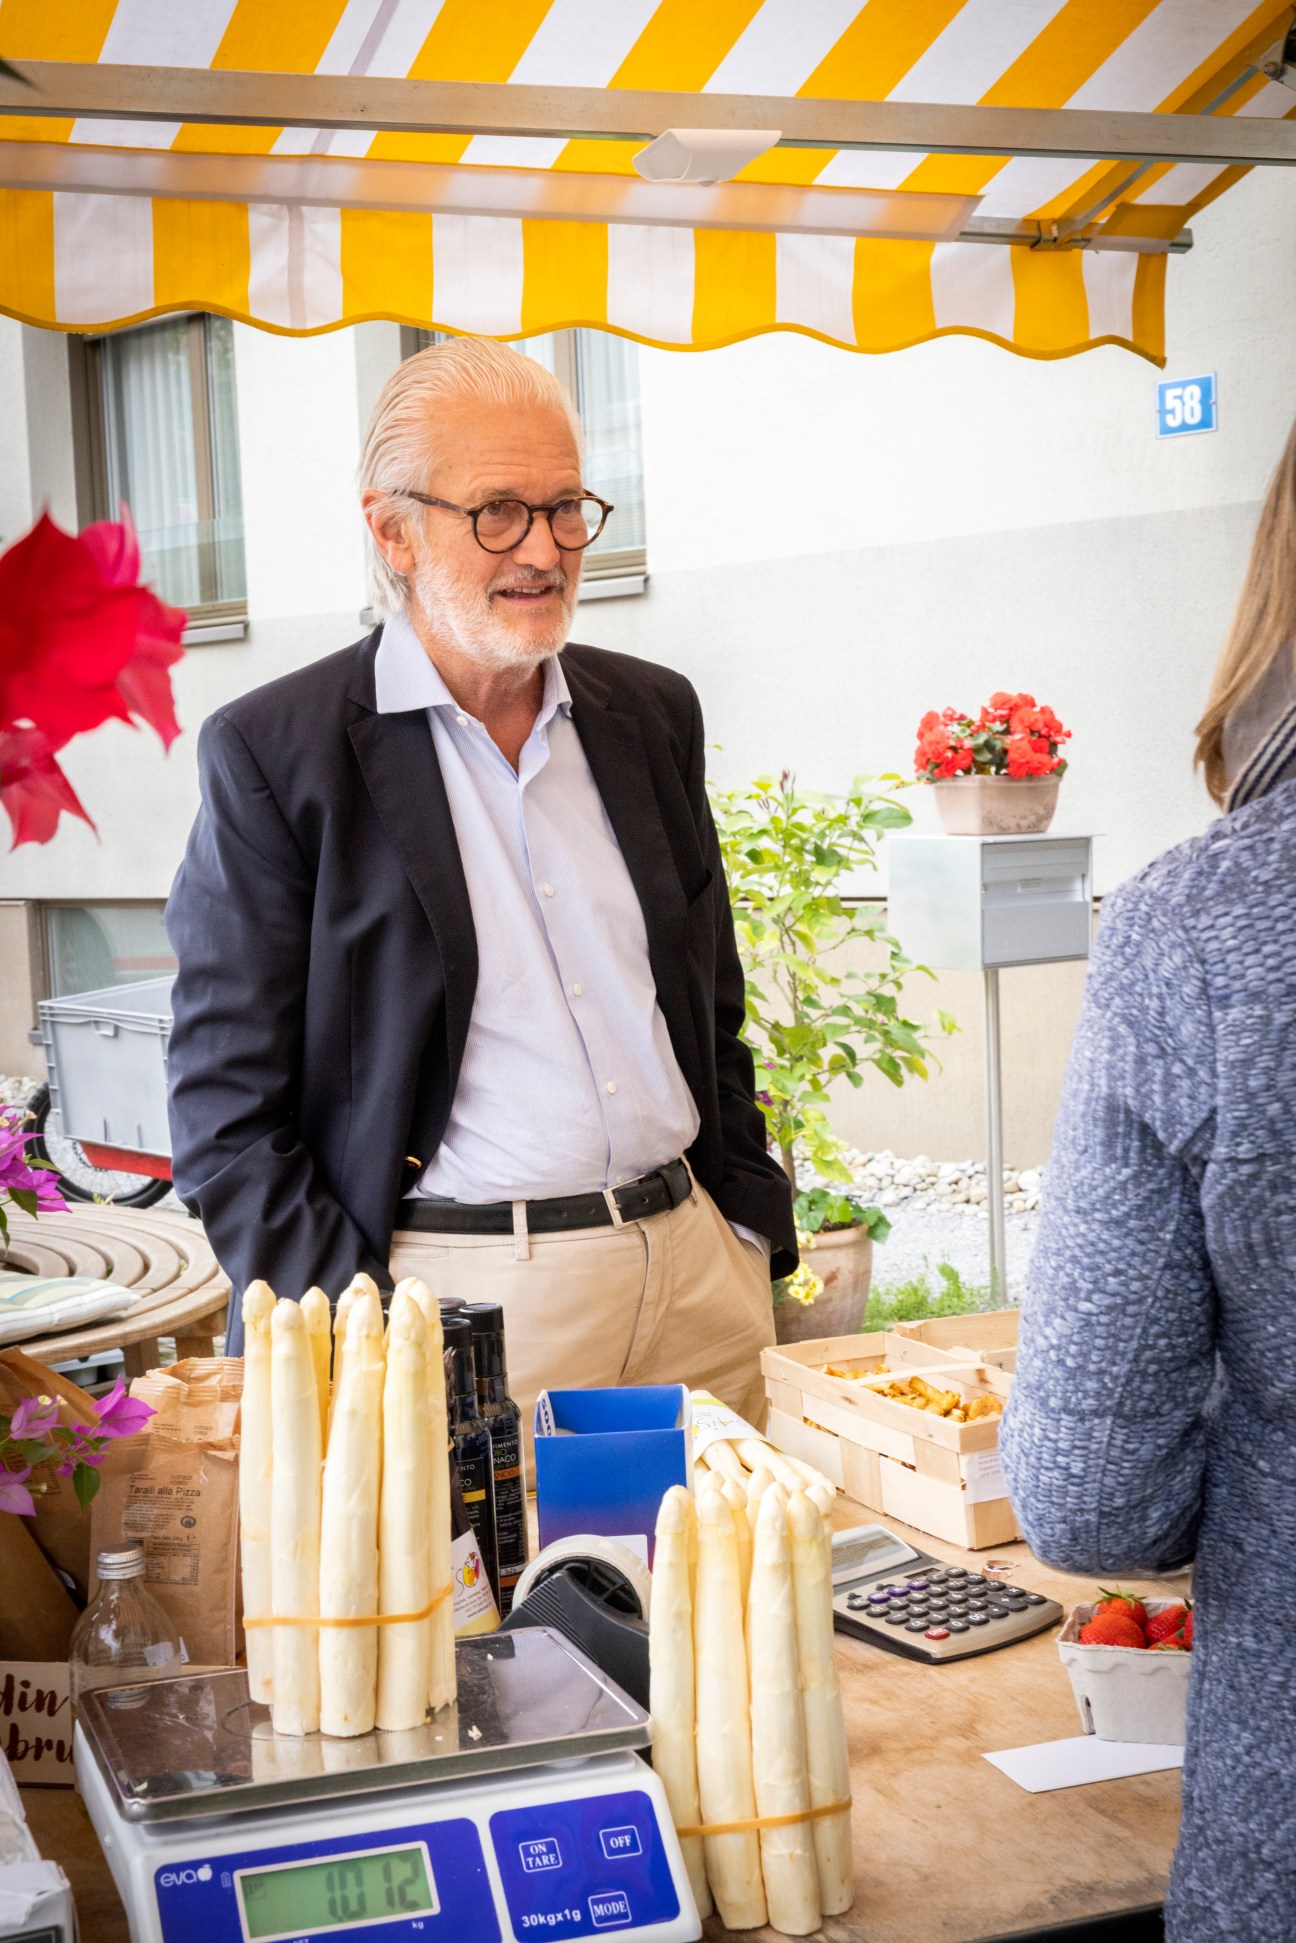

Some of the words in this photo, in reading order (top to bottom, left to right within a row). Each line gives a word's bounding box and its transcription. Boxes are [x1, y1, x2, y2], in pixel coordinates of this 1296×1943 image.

[1165, 384, 1202, 428] 58
[129, 1485, 155, 1495] Taralli
[157, 1486, 173, 1496] alla
[176, 1487, 201, 1497] Pizza
[530, 1843, 547, 1855] ON
[610, 1834, 632, 1849] OFF
[526, 1854, 558, 1869] TARE
[160, 1870, 197, 1887] eva
[593, 1900, 628, 1918] MODE
[411, 1919, 424, 1931] kg
[521, 1908, 582, 1928] 30kgx1g
